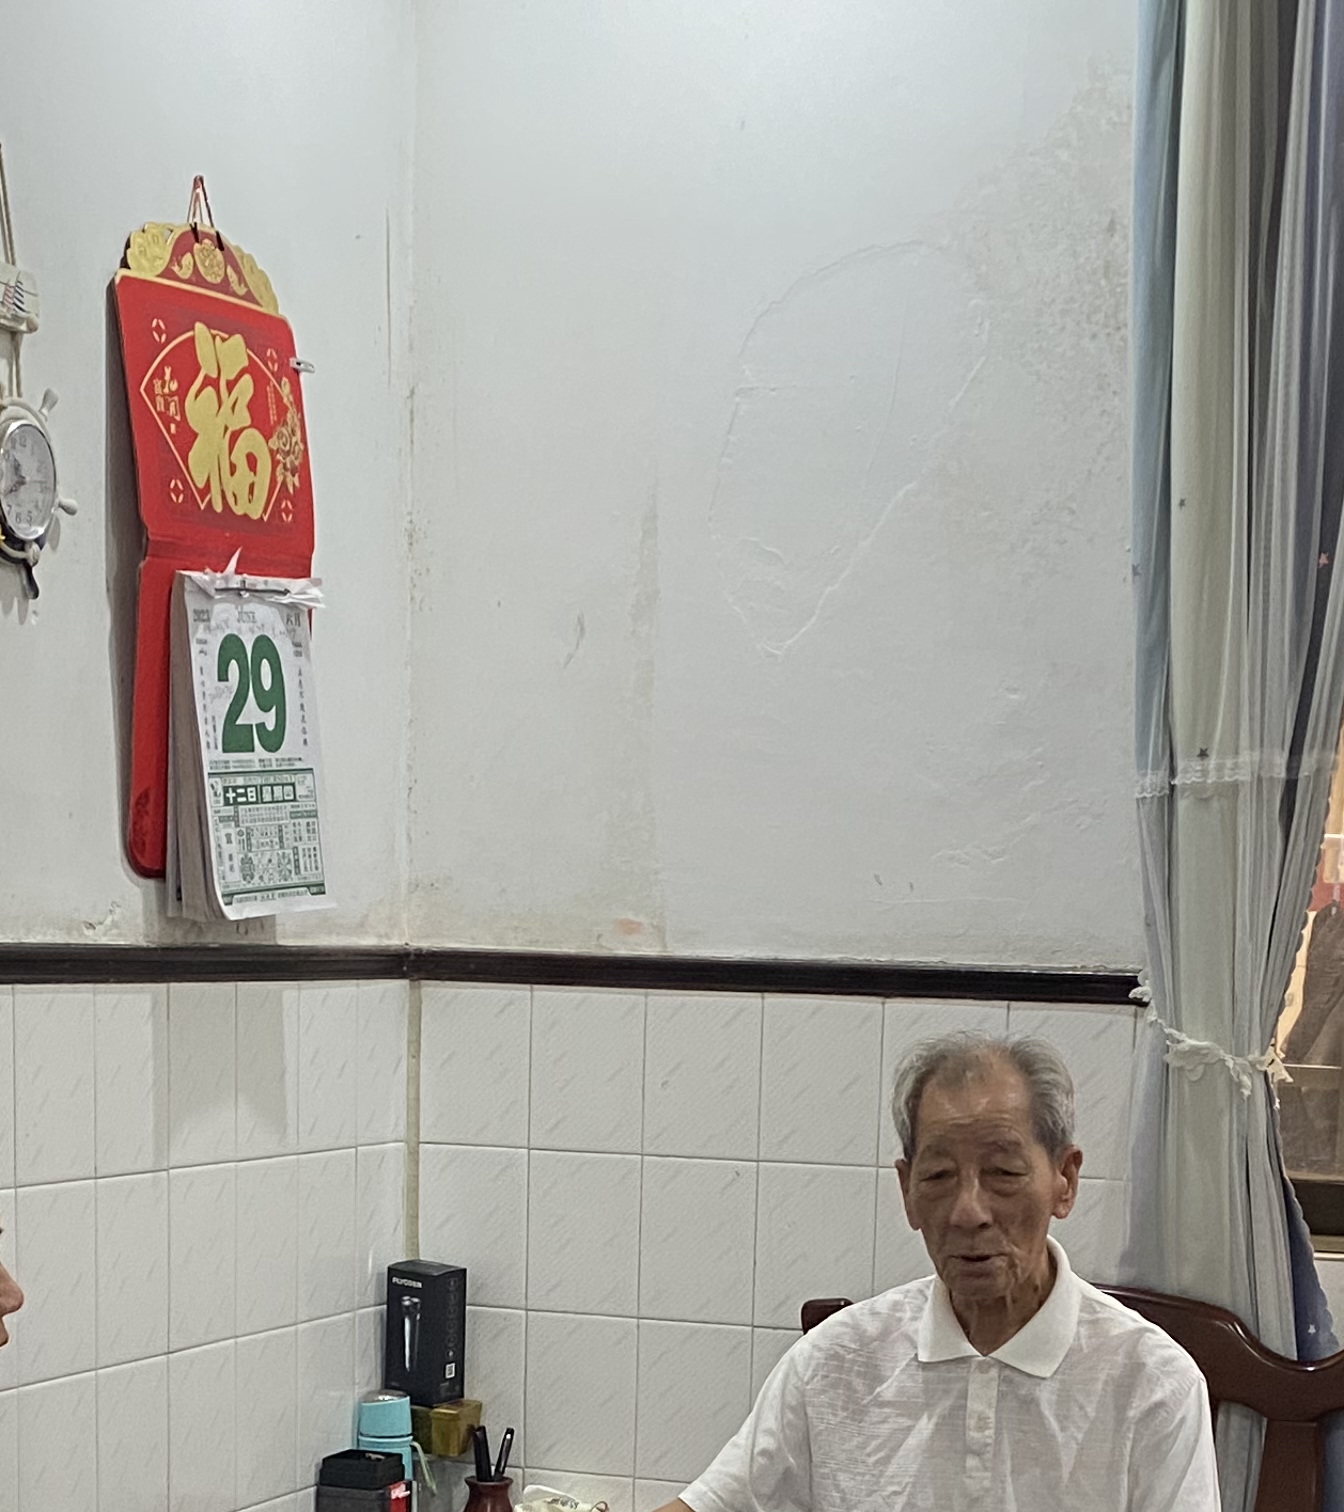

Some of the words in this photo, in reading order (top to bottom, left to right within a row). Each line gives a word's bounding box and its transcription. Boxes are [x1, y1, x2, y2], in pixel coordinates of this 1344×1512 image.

[184, 321, 272, 520] 福
[217, 633, 287, 753] 29
[225, 787, 257, 804] 十二日
